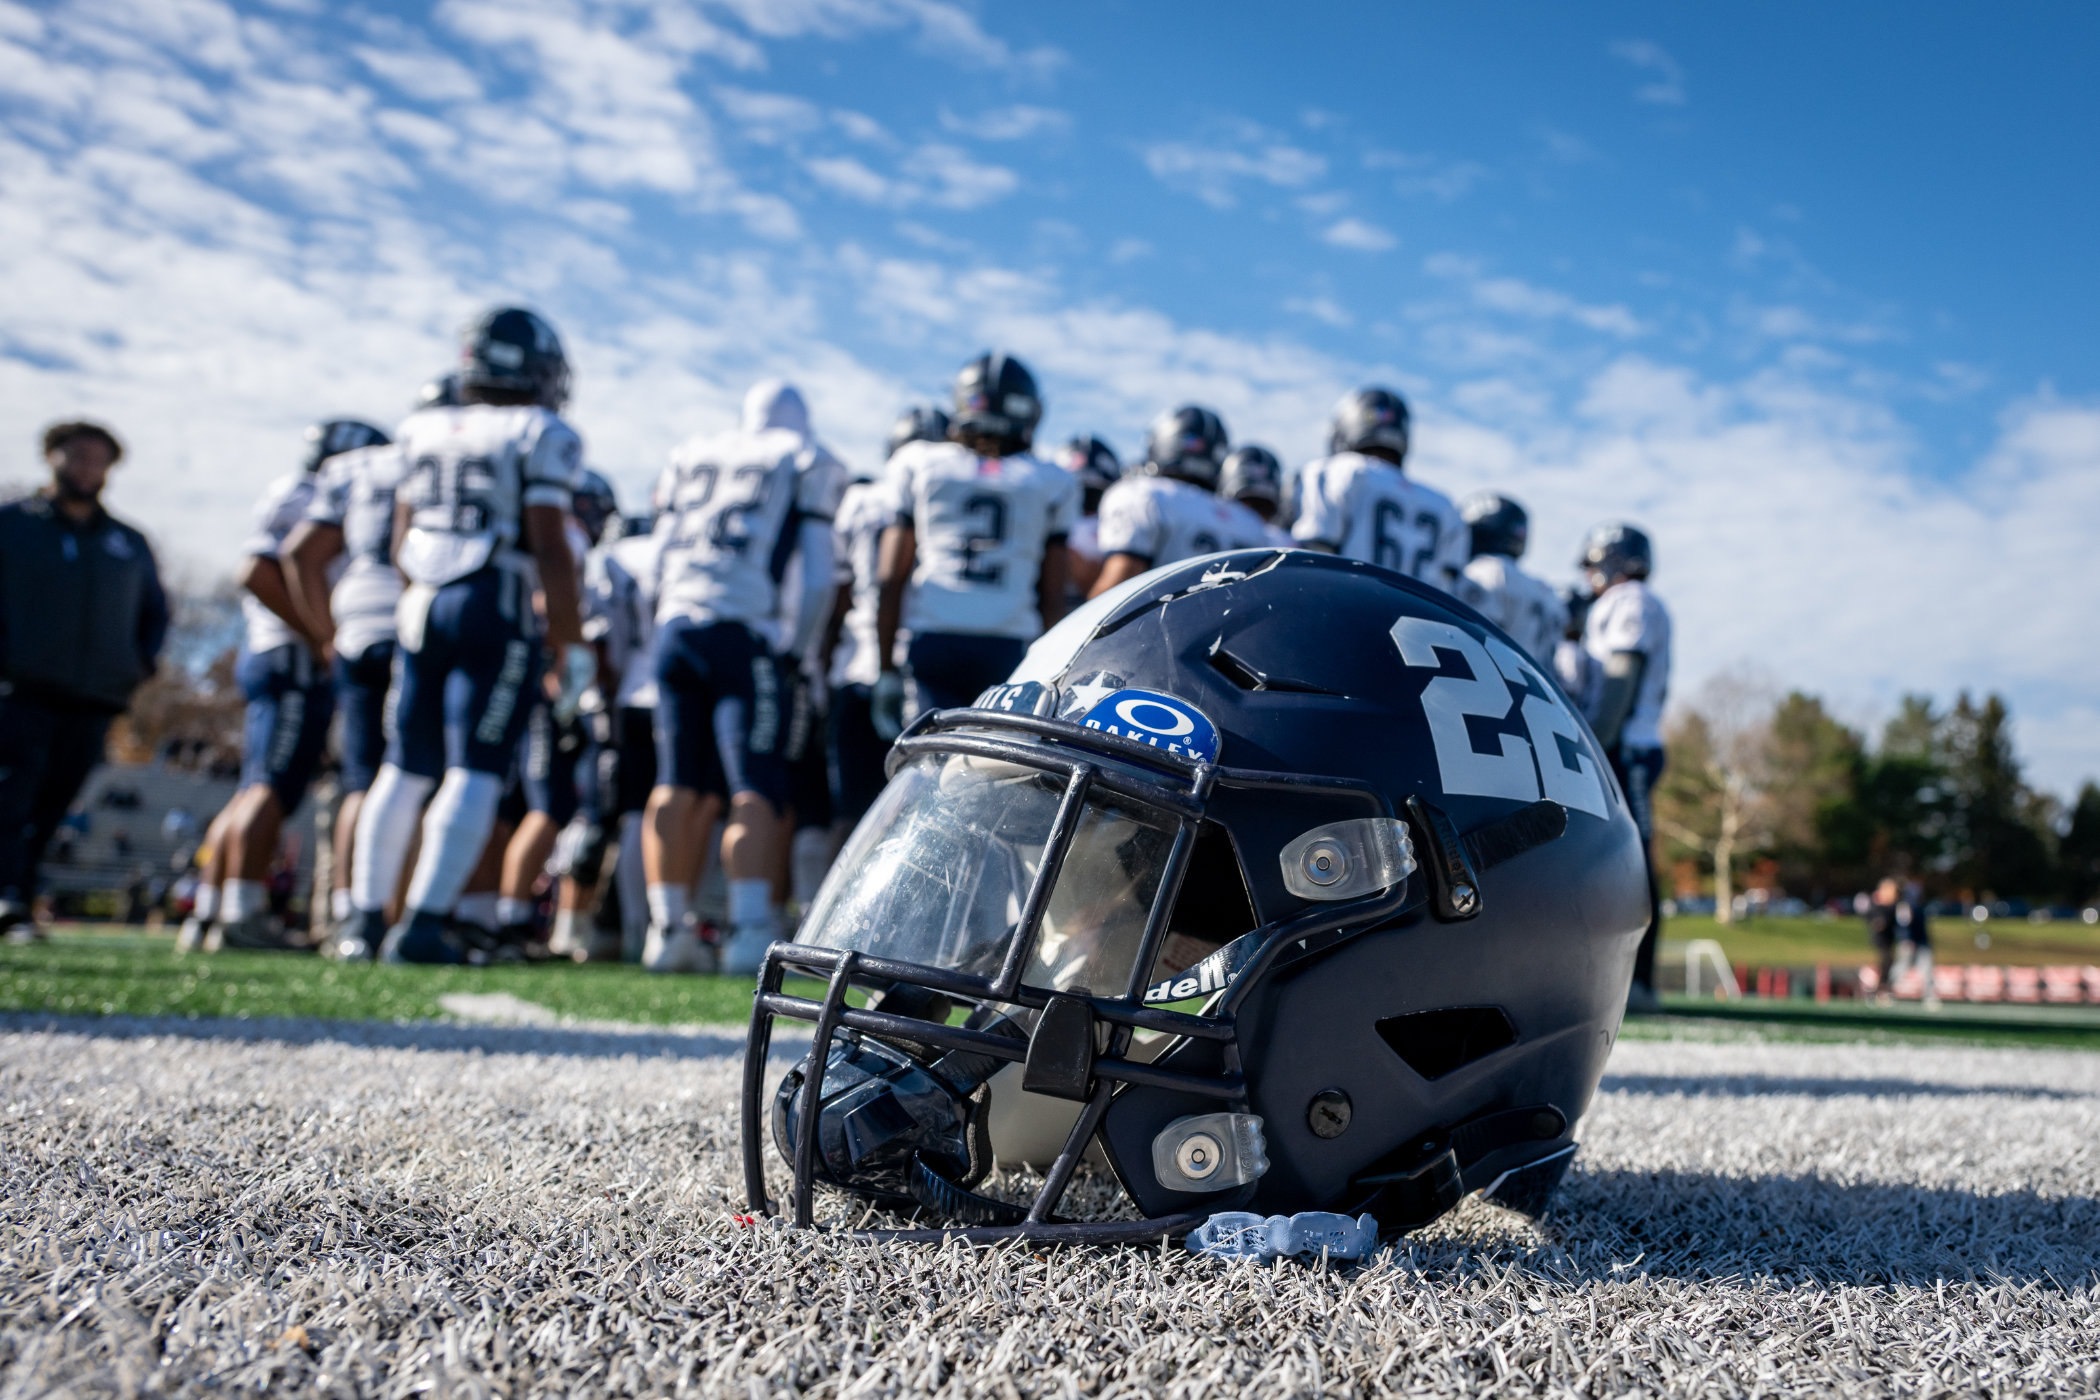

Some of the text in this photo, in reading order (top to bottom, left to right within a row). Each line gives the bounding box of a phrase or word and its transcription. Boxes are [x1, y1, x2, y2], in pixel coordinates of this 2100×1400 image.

[959, 492, 1008, 585] 2
[1373, 496, 1442, 579] 62
[1389, 615, 1610, 821] 22
